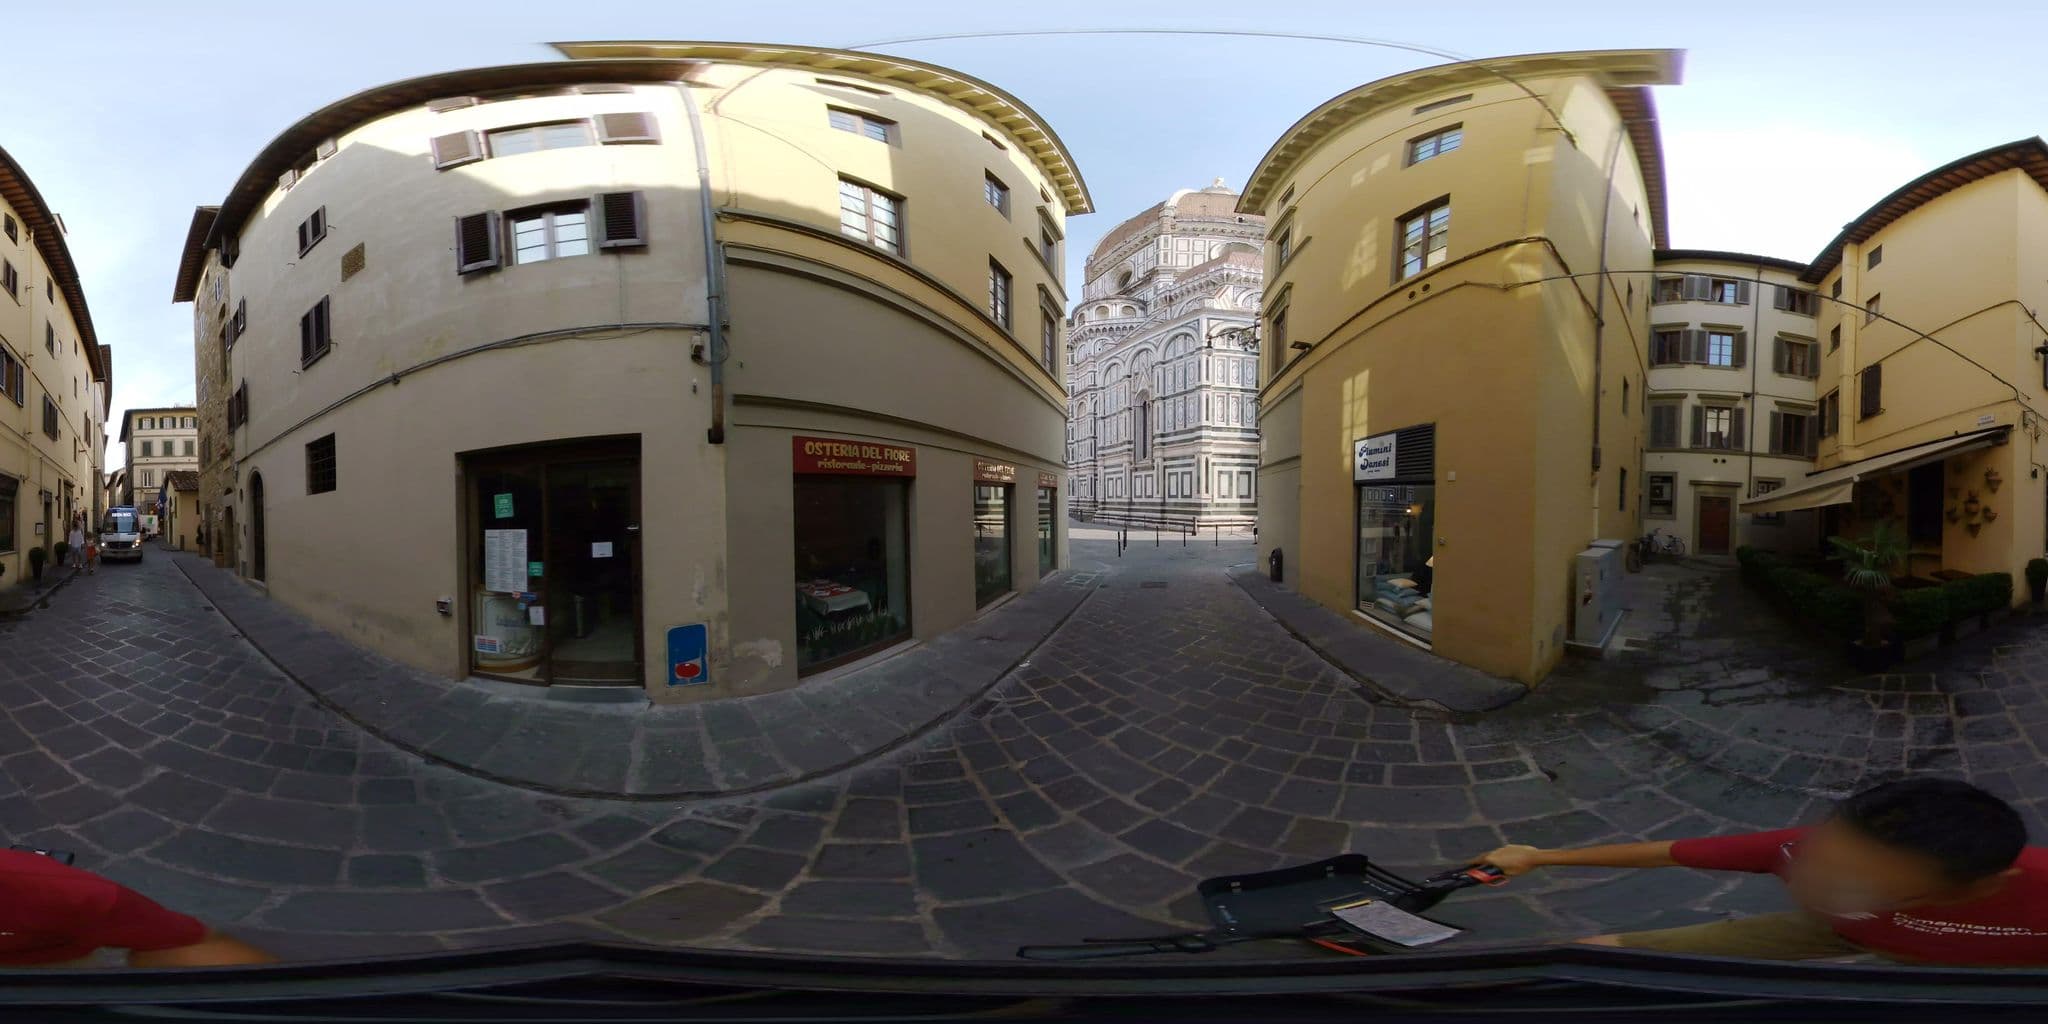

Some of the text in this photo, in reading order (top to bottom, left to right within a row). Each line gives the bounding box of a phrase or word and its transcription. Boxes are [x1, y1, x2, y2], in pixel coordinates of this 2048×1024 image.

[805, 441, 911, 462] OSTERIA DEL FIORE
[1360, 457, 1390, 470] Danesi
